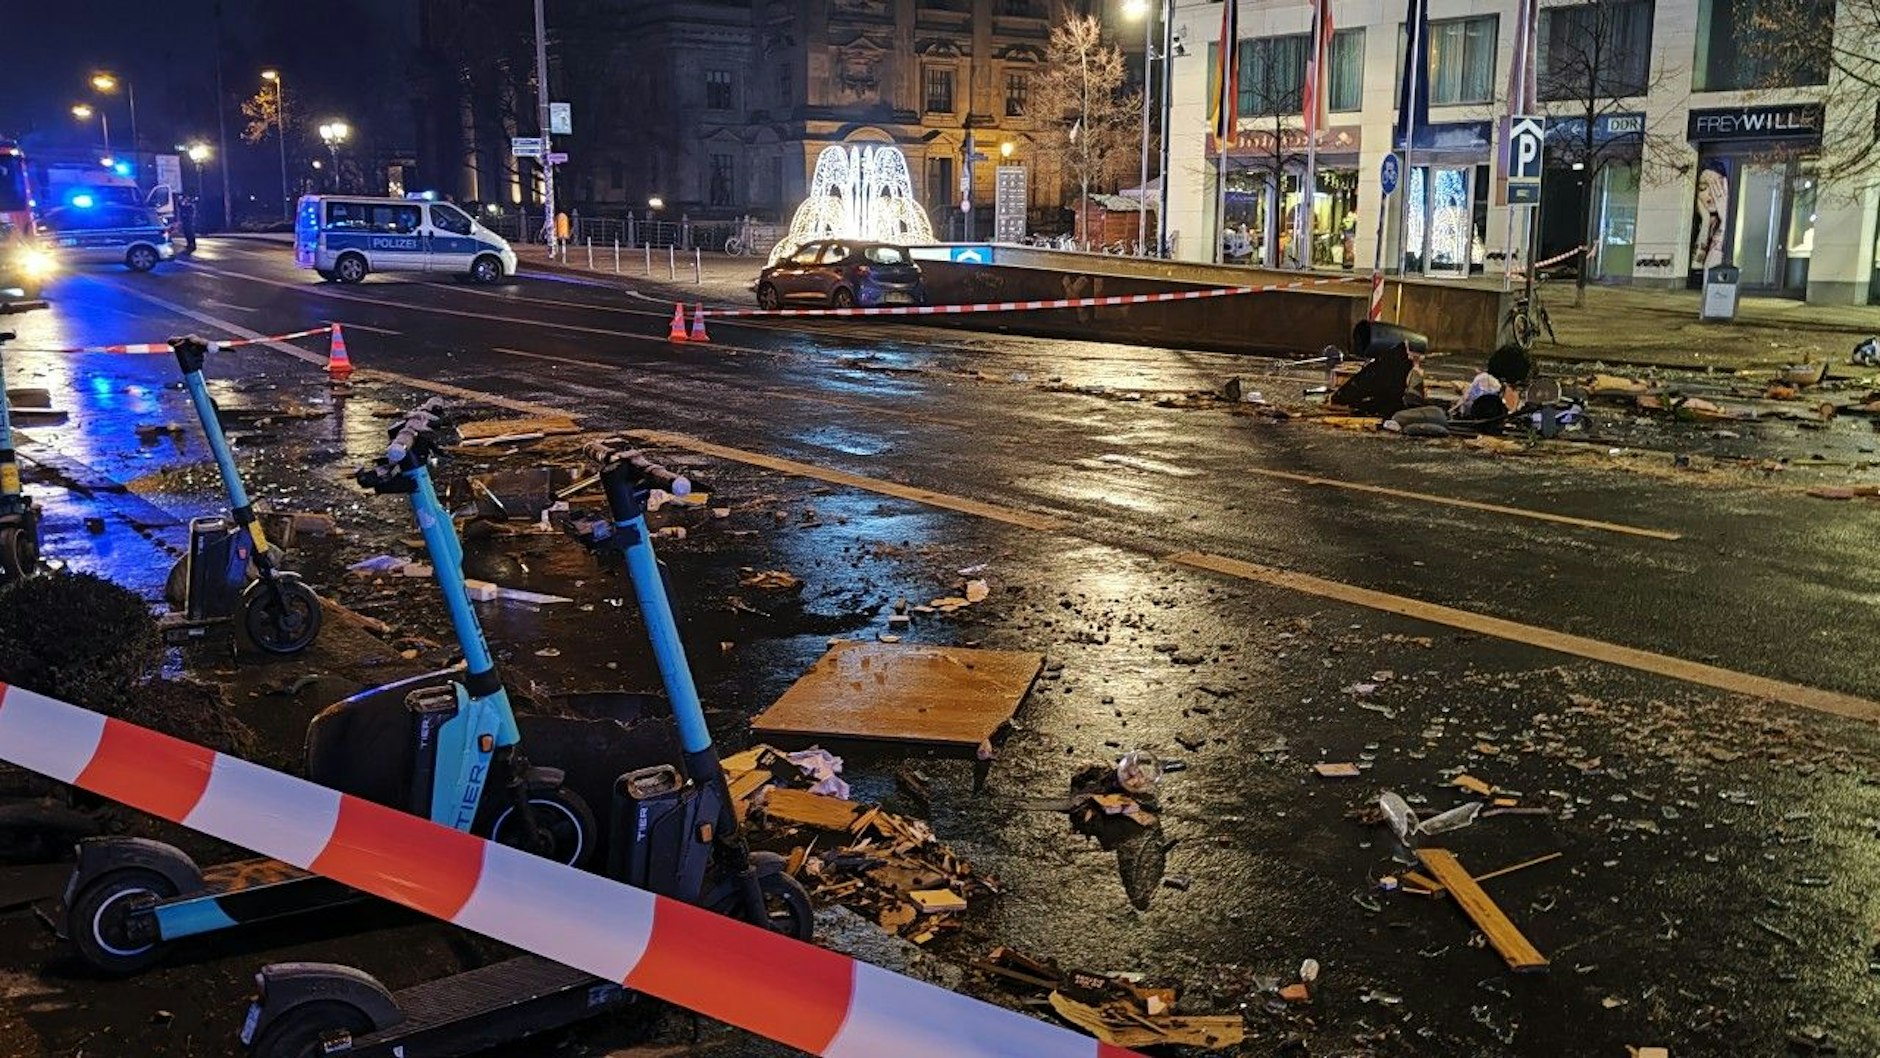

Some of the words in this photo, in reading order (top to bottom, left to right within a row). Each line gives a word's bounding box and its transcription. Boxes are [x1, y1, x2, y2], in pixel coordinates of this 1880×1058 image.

[1610, 119, 1639, 131] DDR
[1518, 133, 1537, 178] P
[372, 237, 417, 249] POLIZEI
[420, 715, 430, 749] TIER
[455, 764, 486, 829] TIER
[636, 806, 649, 842] TIER
